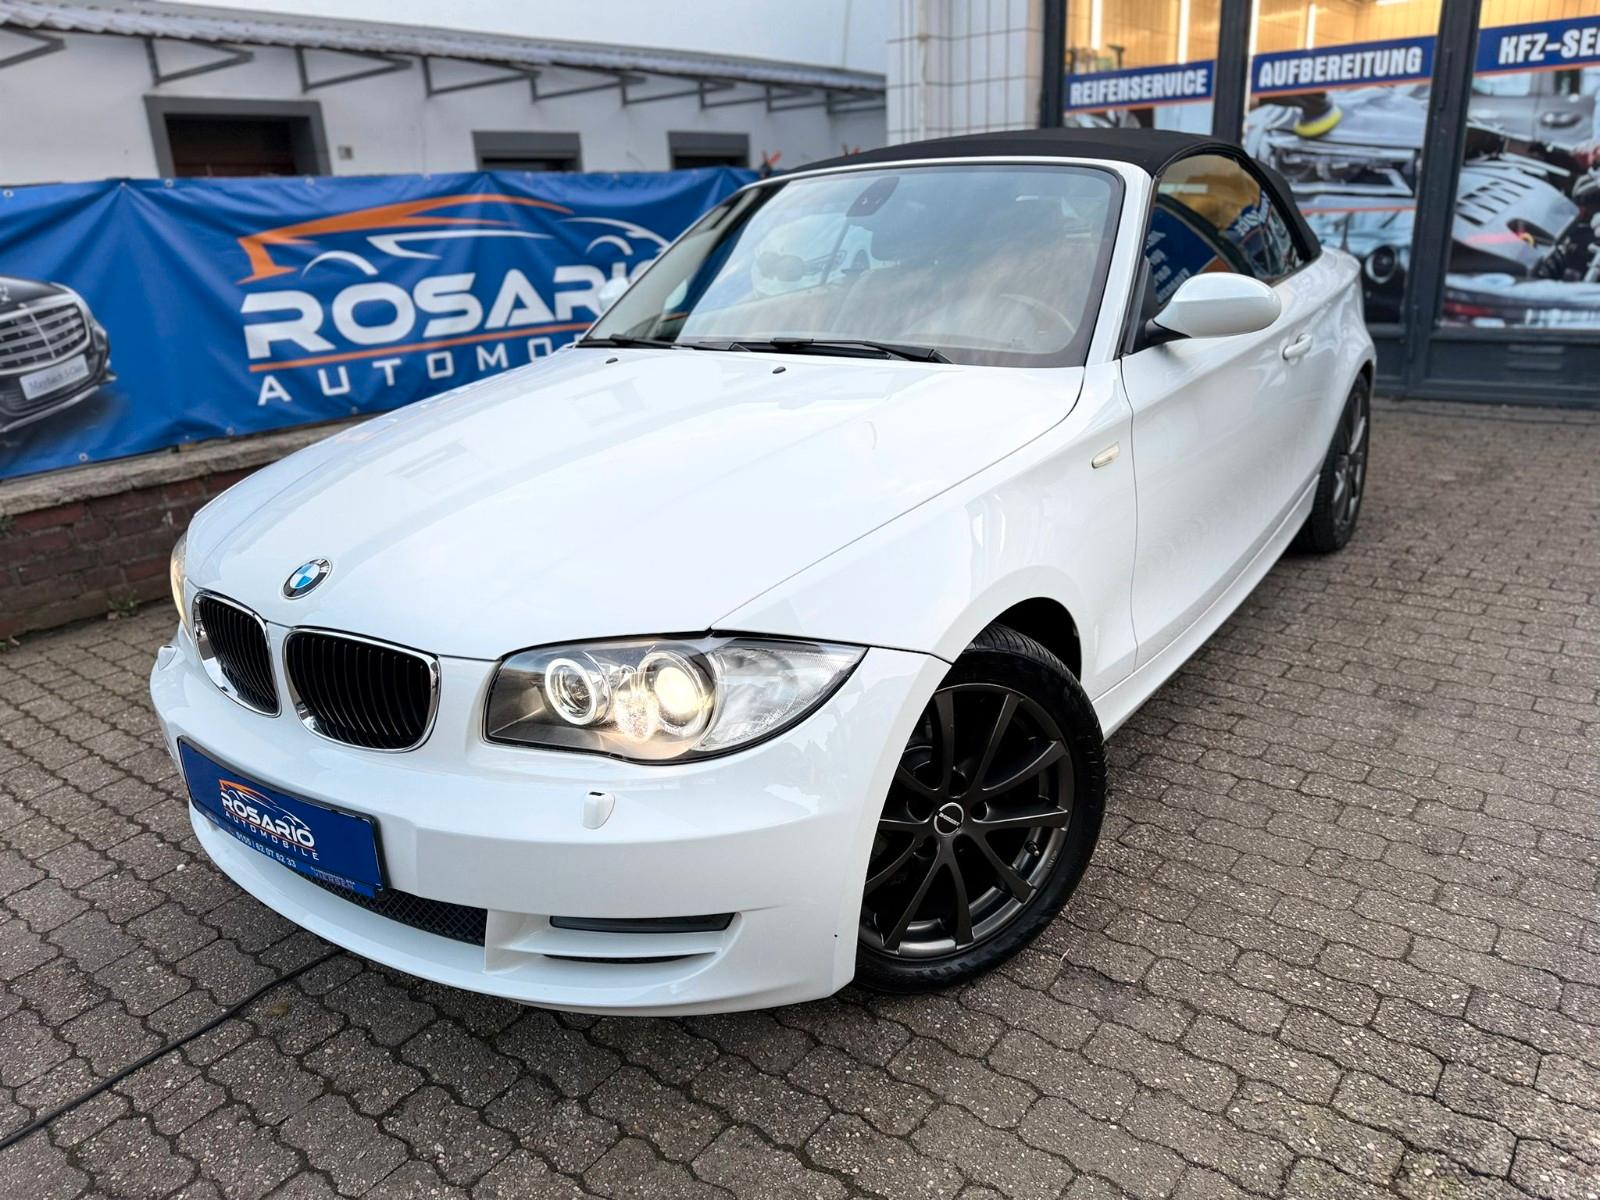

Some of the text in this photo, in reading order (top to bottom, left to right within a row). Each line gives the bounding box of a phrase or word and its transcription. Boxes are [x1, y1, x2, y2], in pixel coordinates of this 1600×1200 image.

[1258, 46, 1423, 88] AUFBEREITUNG
[1498, 27, 1600, 65] KFZ-SE
[1069, 69, 1208, 106] REIFENSERVICE
[257, 334, 582, 405] AUTOMO
[221, 792, 315, 848] ROSARIO
[225, 811, 319, 861] AUTOMOBILE
